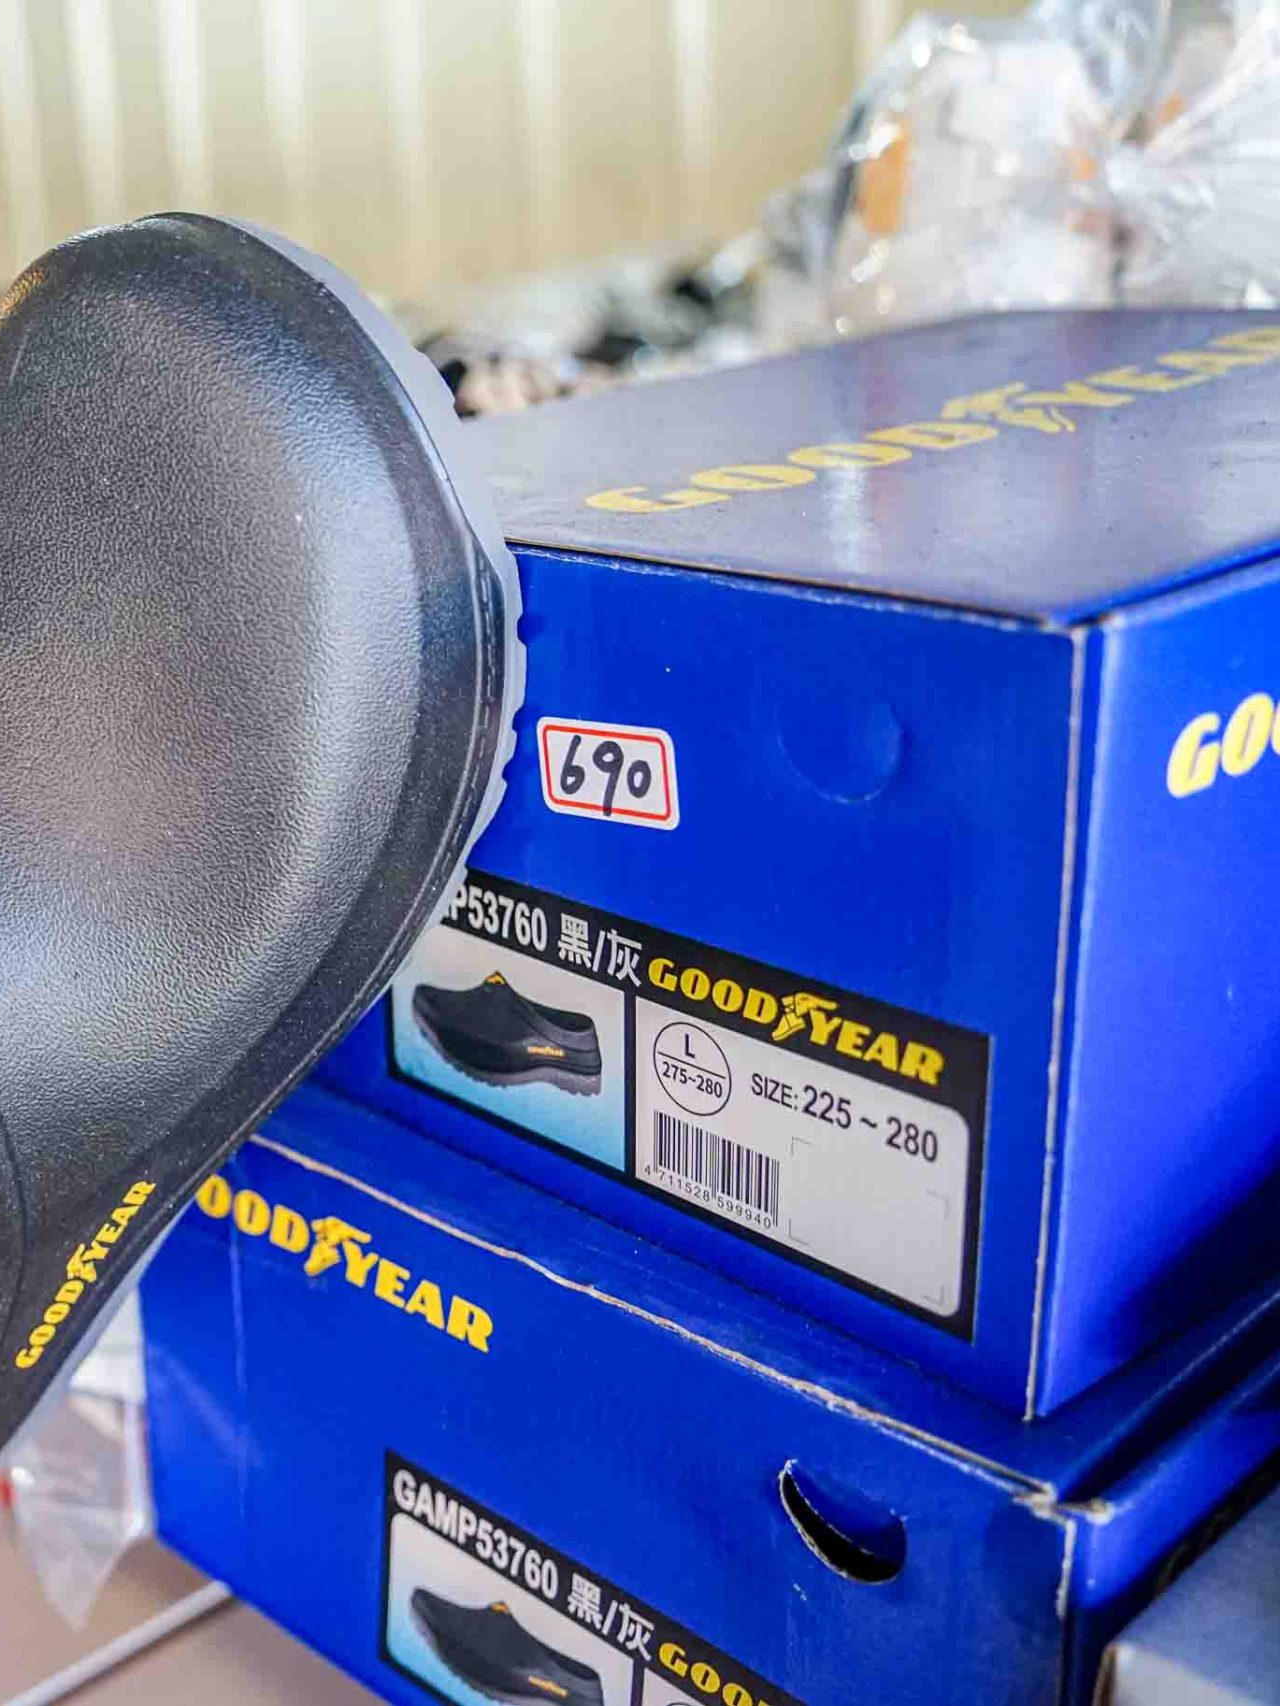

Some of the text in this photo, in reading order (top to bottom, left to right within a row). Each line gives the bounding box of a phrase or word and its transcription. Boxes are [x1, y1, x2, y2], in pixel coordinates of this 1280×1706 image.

[559, 735, 652, 817] 690
[1166, 692, 1280, 798] GO
[447, 883, 643, 988] P53760 黑/灰
[648, 956, 946, 1087] GOODYEAR
[685, 1033, 696, 1059] L
[662, 1061, 723, 1099] 275~280
[15, 1181, 156, 1369] GOODYEAR
[195, 1173, 494, 1353] OODYEAR
[393, 1468, 655, 1661] GAMP53760 黑/灰
[659, 1642, 771, 1706] GOO
